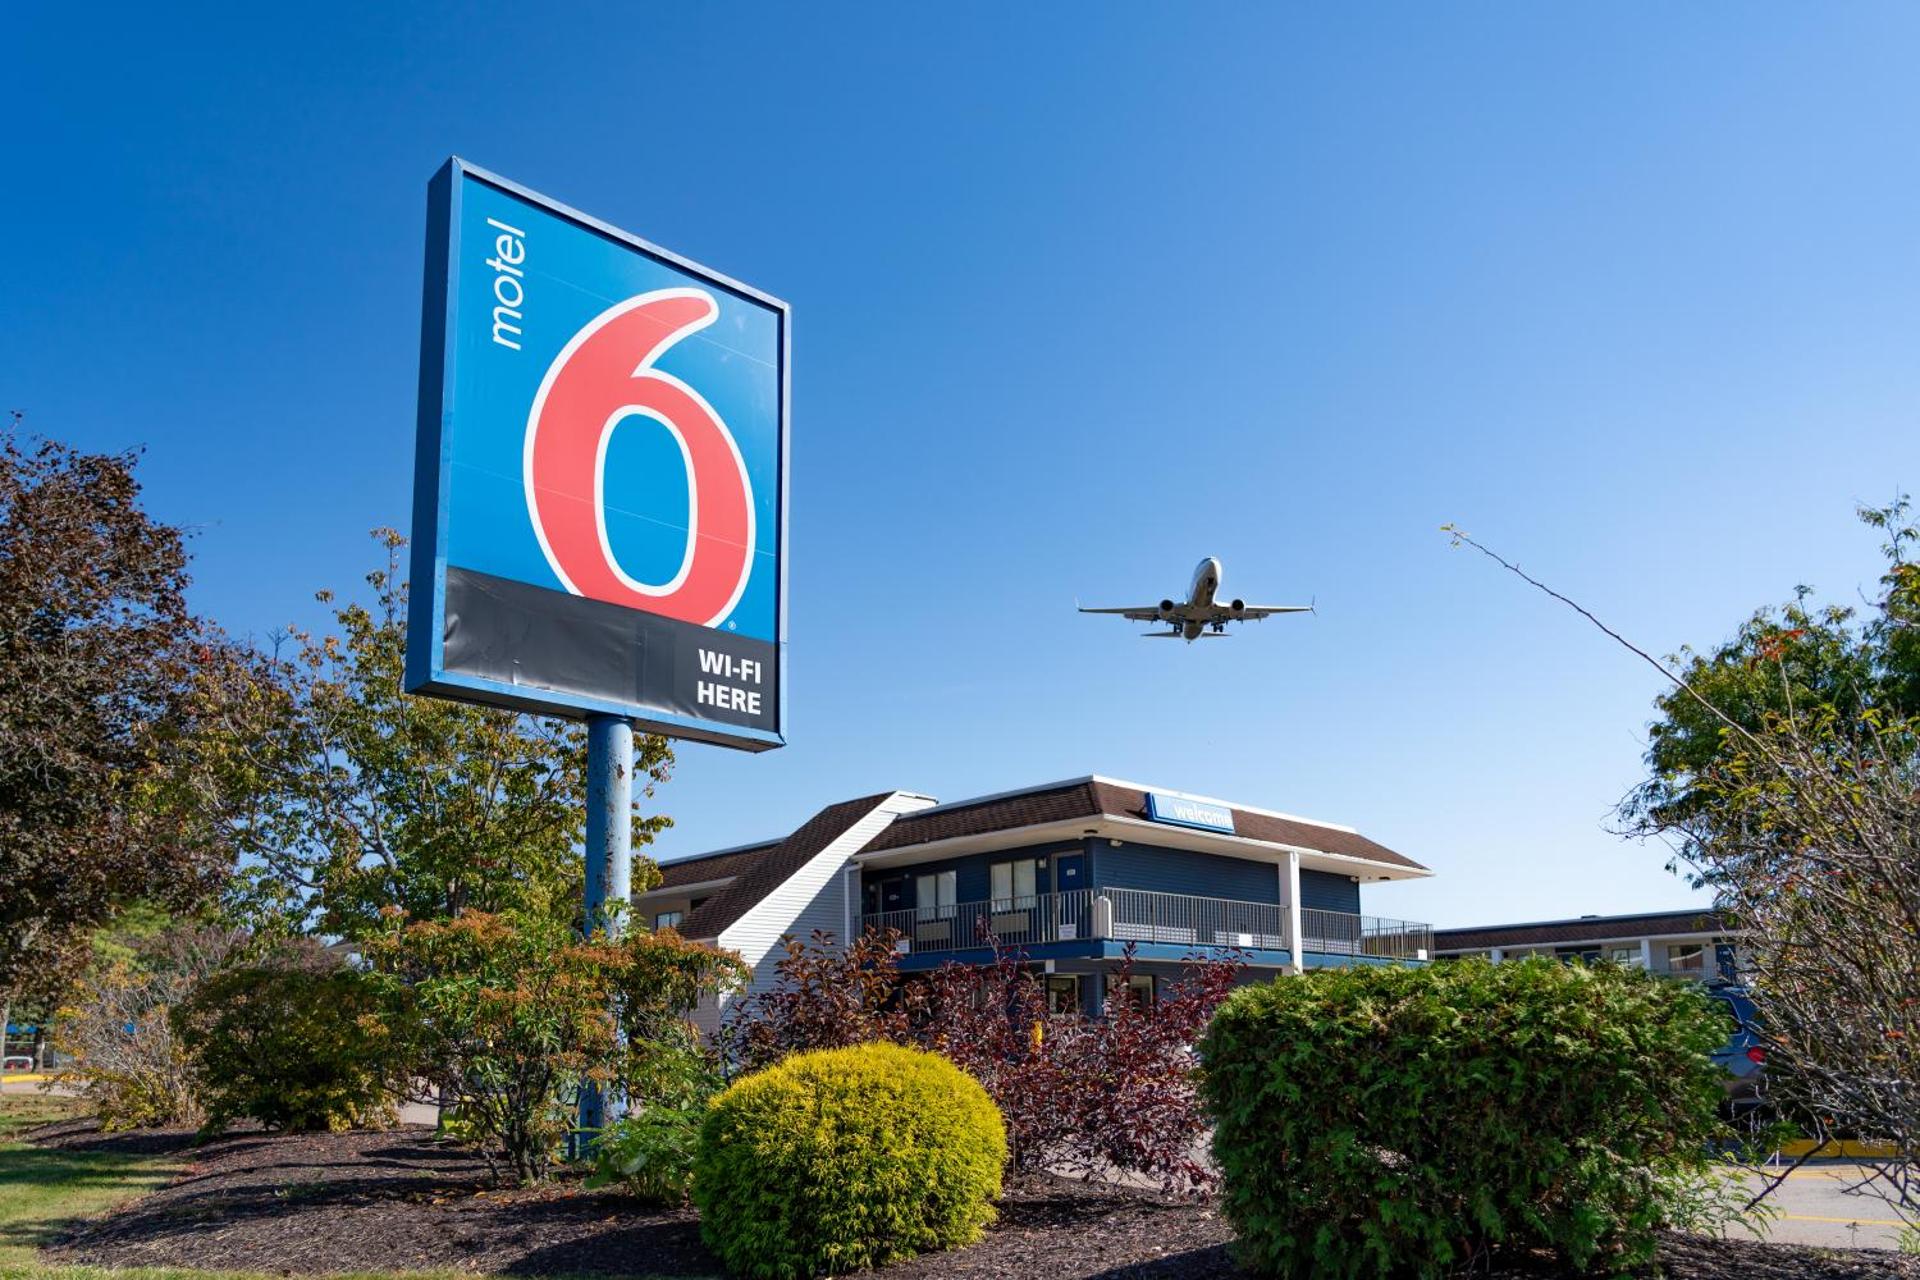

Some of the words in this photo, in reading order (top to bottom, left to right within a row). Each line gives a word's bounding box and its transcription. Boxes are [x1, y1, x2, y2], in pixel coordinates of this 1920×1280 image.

[486, 217, 526, 351] motel
[523, 287, 756, 629] 6
[697, 681, 761, 715] HERE
[698, 649, 761, 684] WI-FI
